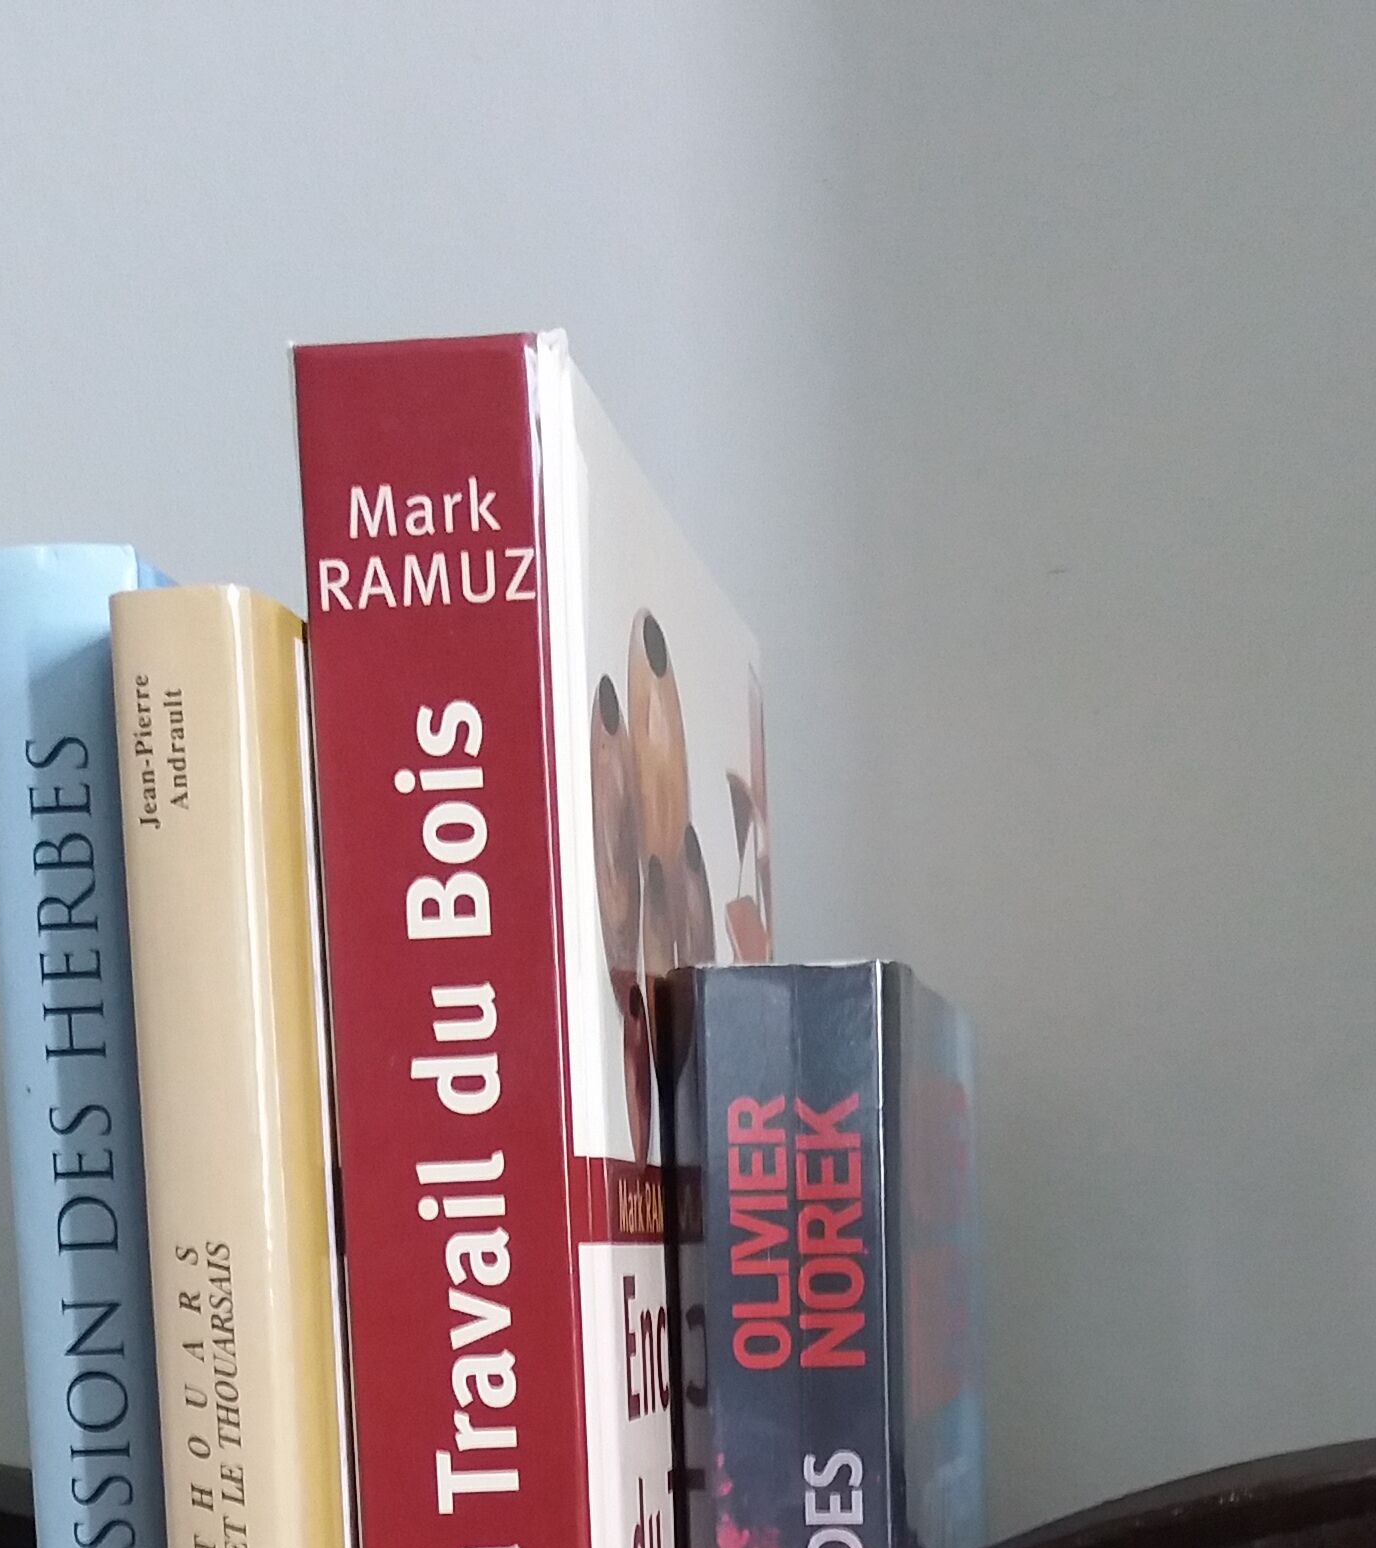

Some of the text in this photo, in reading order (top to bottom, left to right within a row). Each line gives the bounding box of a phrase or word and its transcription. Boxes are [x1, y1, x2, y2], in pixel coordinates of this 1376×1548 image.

[318, 547, 537, 613] RAMUZ
[348, 476, 502, 540] Mark
[135, 673, 162, 830] Jean-Pierre
[167, 687, 191, 811] Andrault
[394, 700, 493, 940] Bois
[25, 734, 107, 1061] HERBES
[410, 981, 502, 1115] du
[48, 1103, 120, 1256] DES
[618, 1179, 644, 1234] Mark
[728, 1095, 792, 1371] OLIVIER
[795, 1091, 867, 1369] NOREK
[206, 1241, 242, 1449] THOUARSAIS
[415, 1150, 520, 1515] Travail
[221, 1463, 246, 1507] LE
